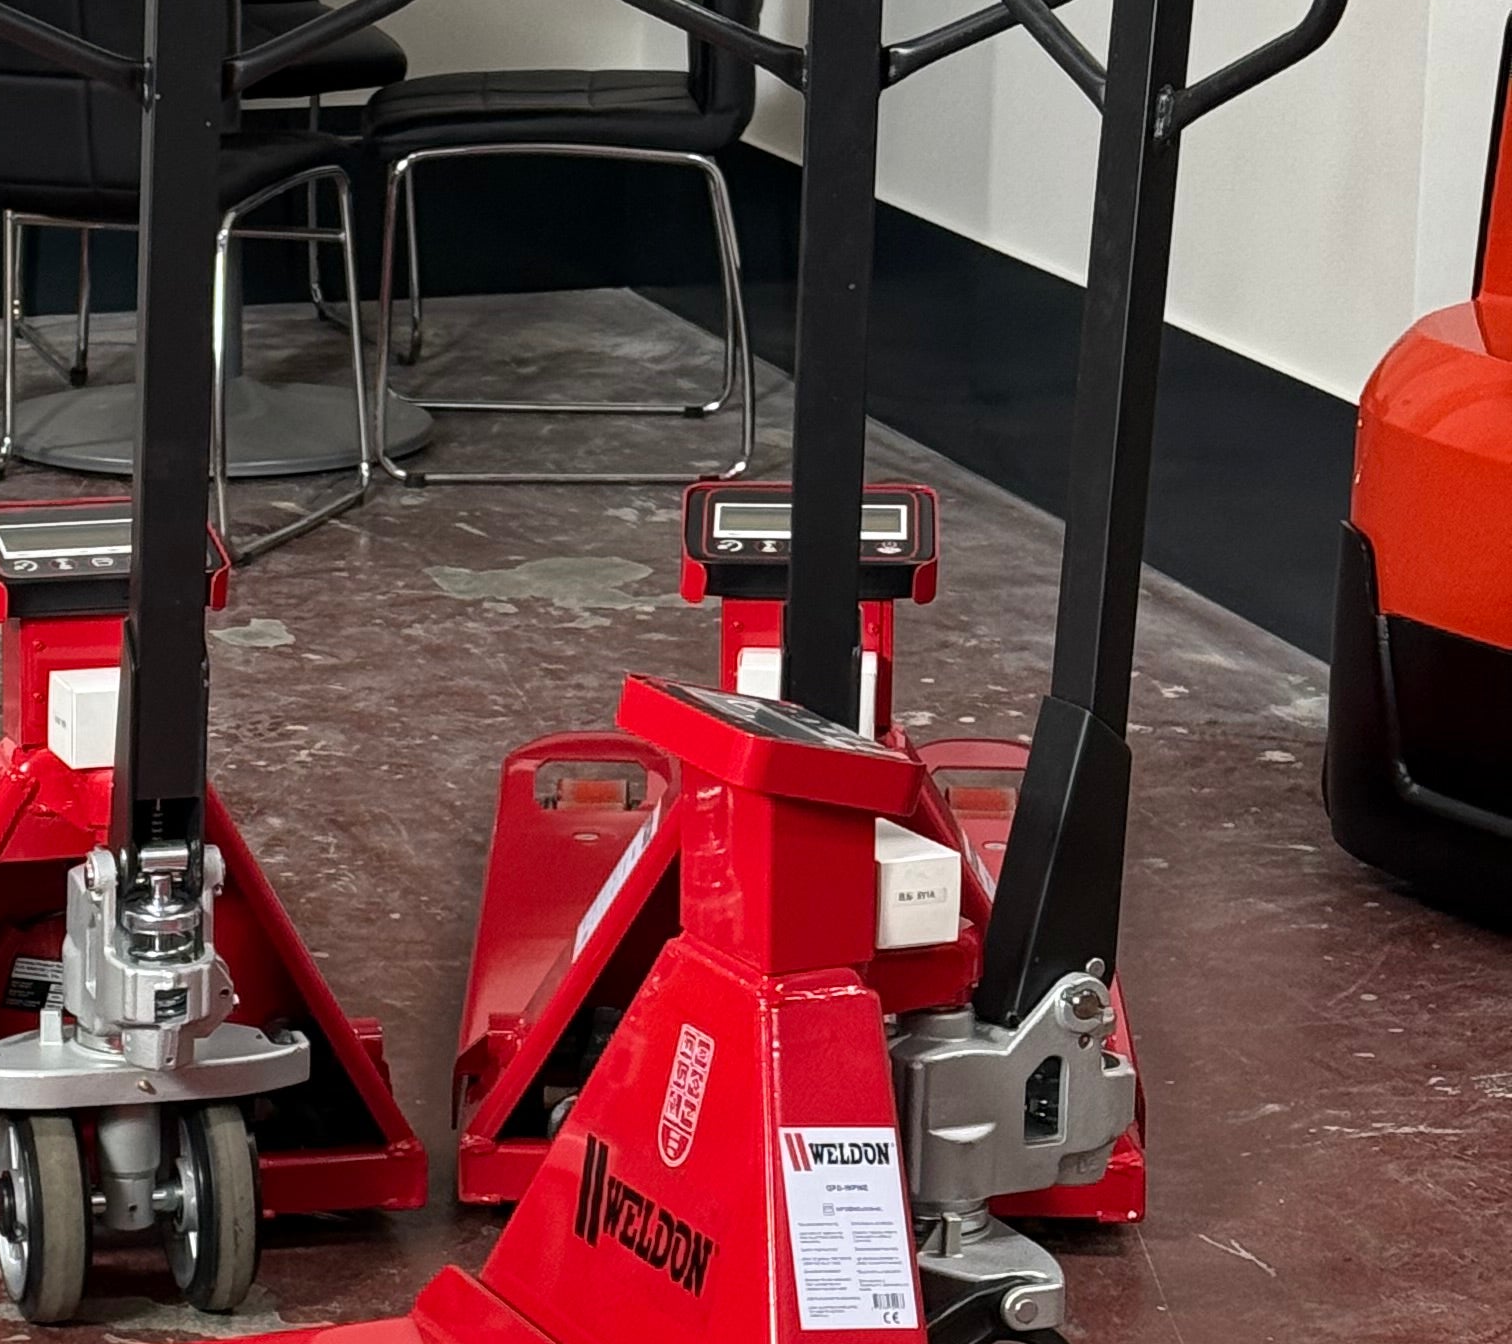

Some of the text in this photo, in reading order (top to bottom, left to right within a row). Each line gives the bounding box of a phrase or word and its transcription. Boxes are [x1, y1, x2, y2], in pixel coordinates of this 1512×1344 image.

[808, 1142, 890, 1165] WELDON
[603, 1175, 714, 1299] WELDON
[882, 1311, 901, 1324] CE
